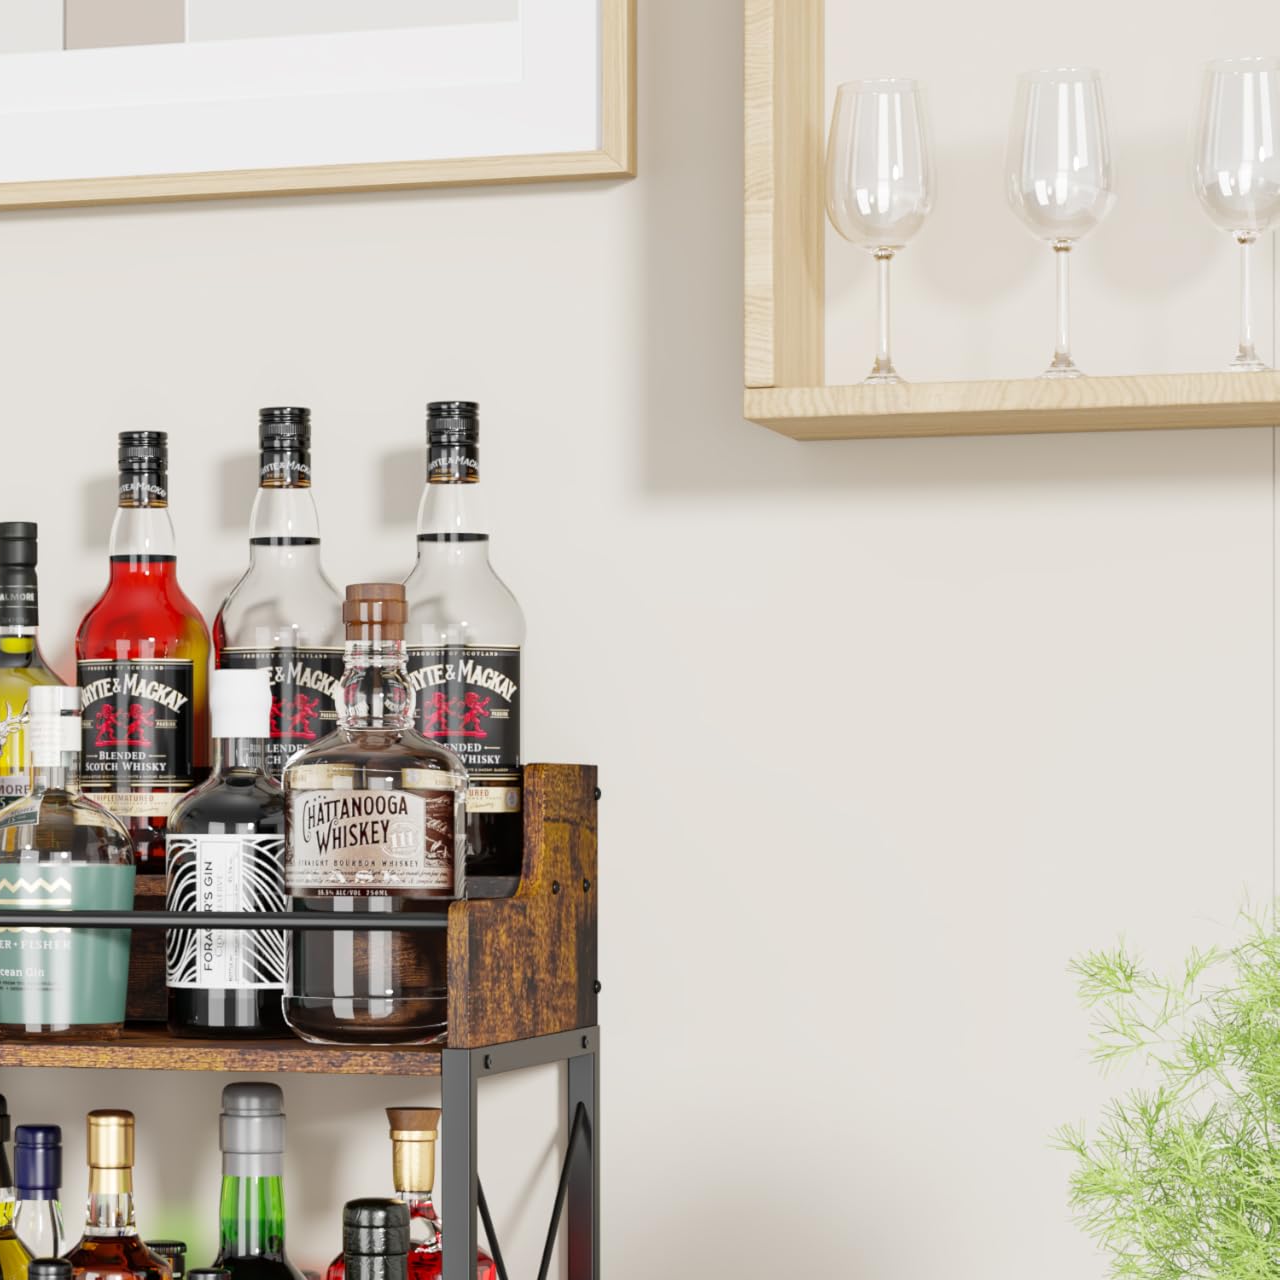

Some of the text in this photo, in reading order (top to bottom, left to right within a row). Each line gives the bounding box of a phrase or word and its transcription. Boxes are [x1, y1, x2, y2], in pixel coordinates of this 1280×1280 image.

[112, 677, 122, 693] &
[122, 672, 190, 714] MACKAY
[286, 661, 340, 700] MACKA
[445, 664, 457, 681] &
[457, 659, 518, 703] MACKAY
[98, 750, 147, 761] BLENDED
[267, 743, 309, 753] LENDE
[85, 761, 167, 772] SCOTCH WHISKY
[315, 817, 390, 856] WHISKEY
[204, 861, 214, 888] GIN
[333, 860, 376, 868] BOURBON
[381, 860, 419, 868] WHISKEY
